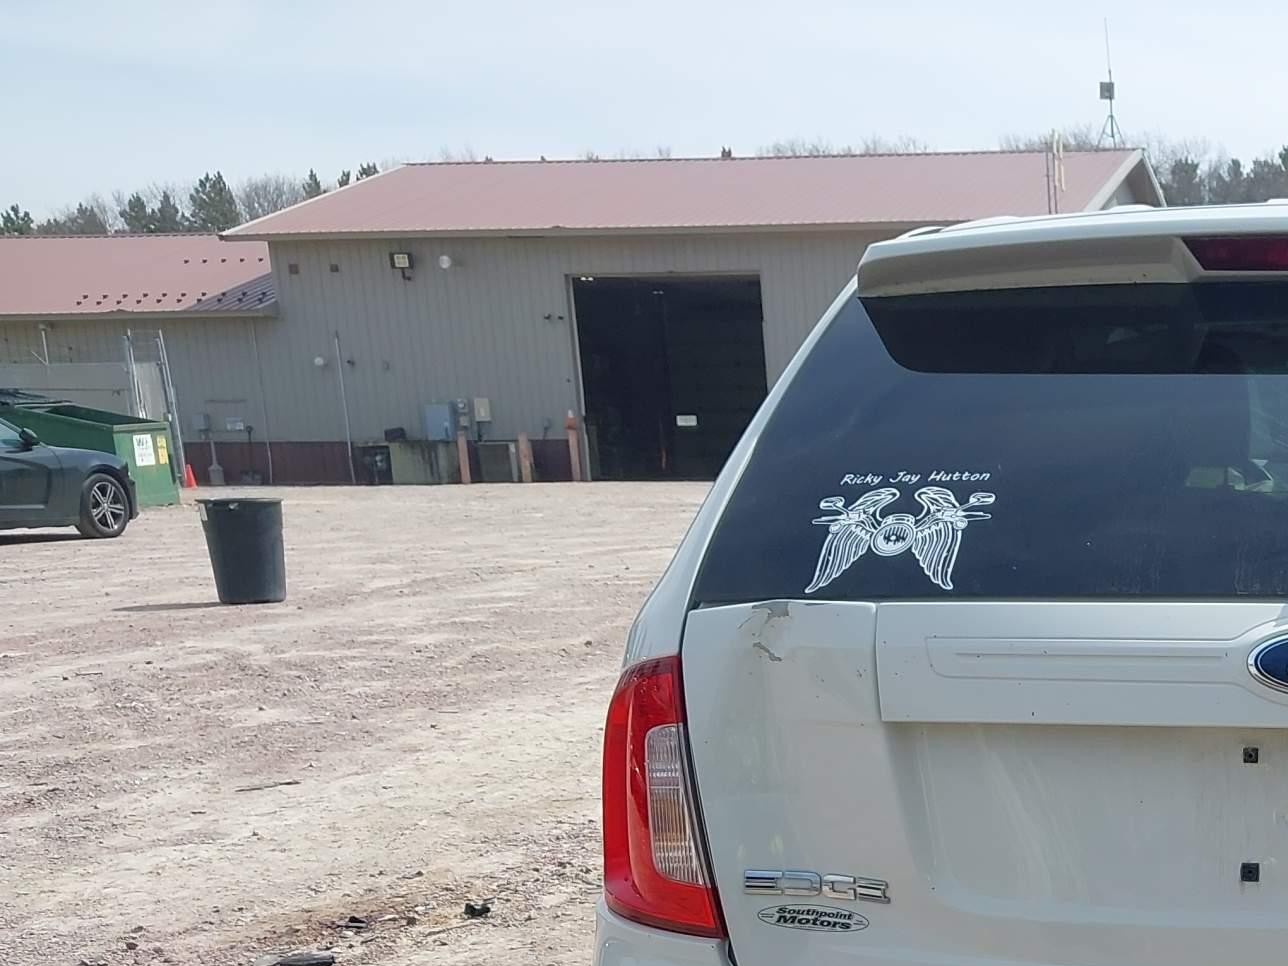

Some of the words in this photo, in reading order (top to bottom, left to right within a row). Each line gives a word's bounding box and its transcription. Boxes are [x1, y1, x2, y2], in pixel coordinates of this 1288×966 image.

[840, 473, 883, 486] Ricky
[889, 471, 921, 484] Jay
[928, 470, 991, 482] Hutton
[743, 869, 892, 905] EDGE
[775, 906, 854, 921] Southpoint
[775, 914, 853, 930] Motors
